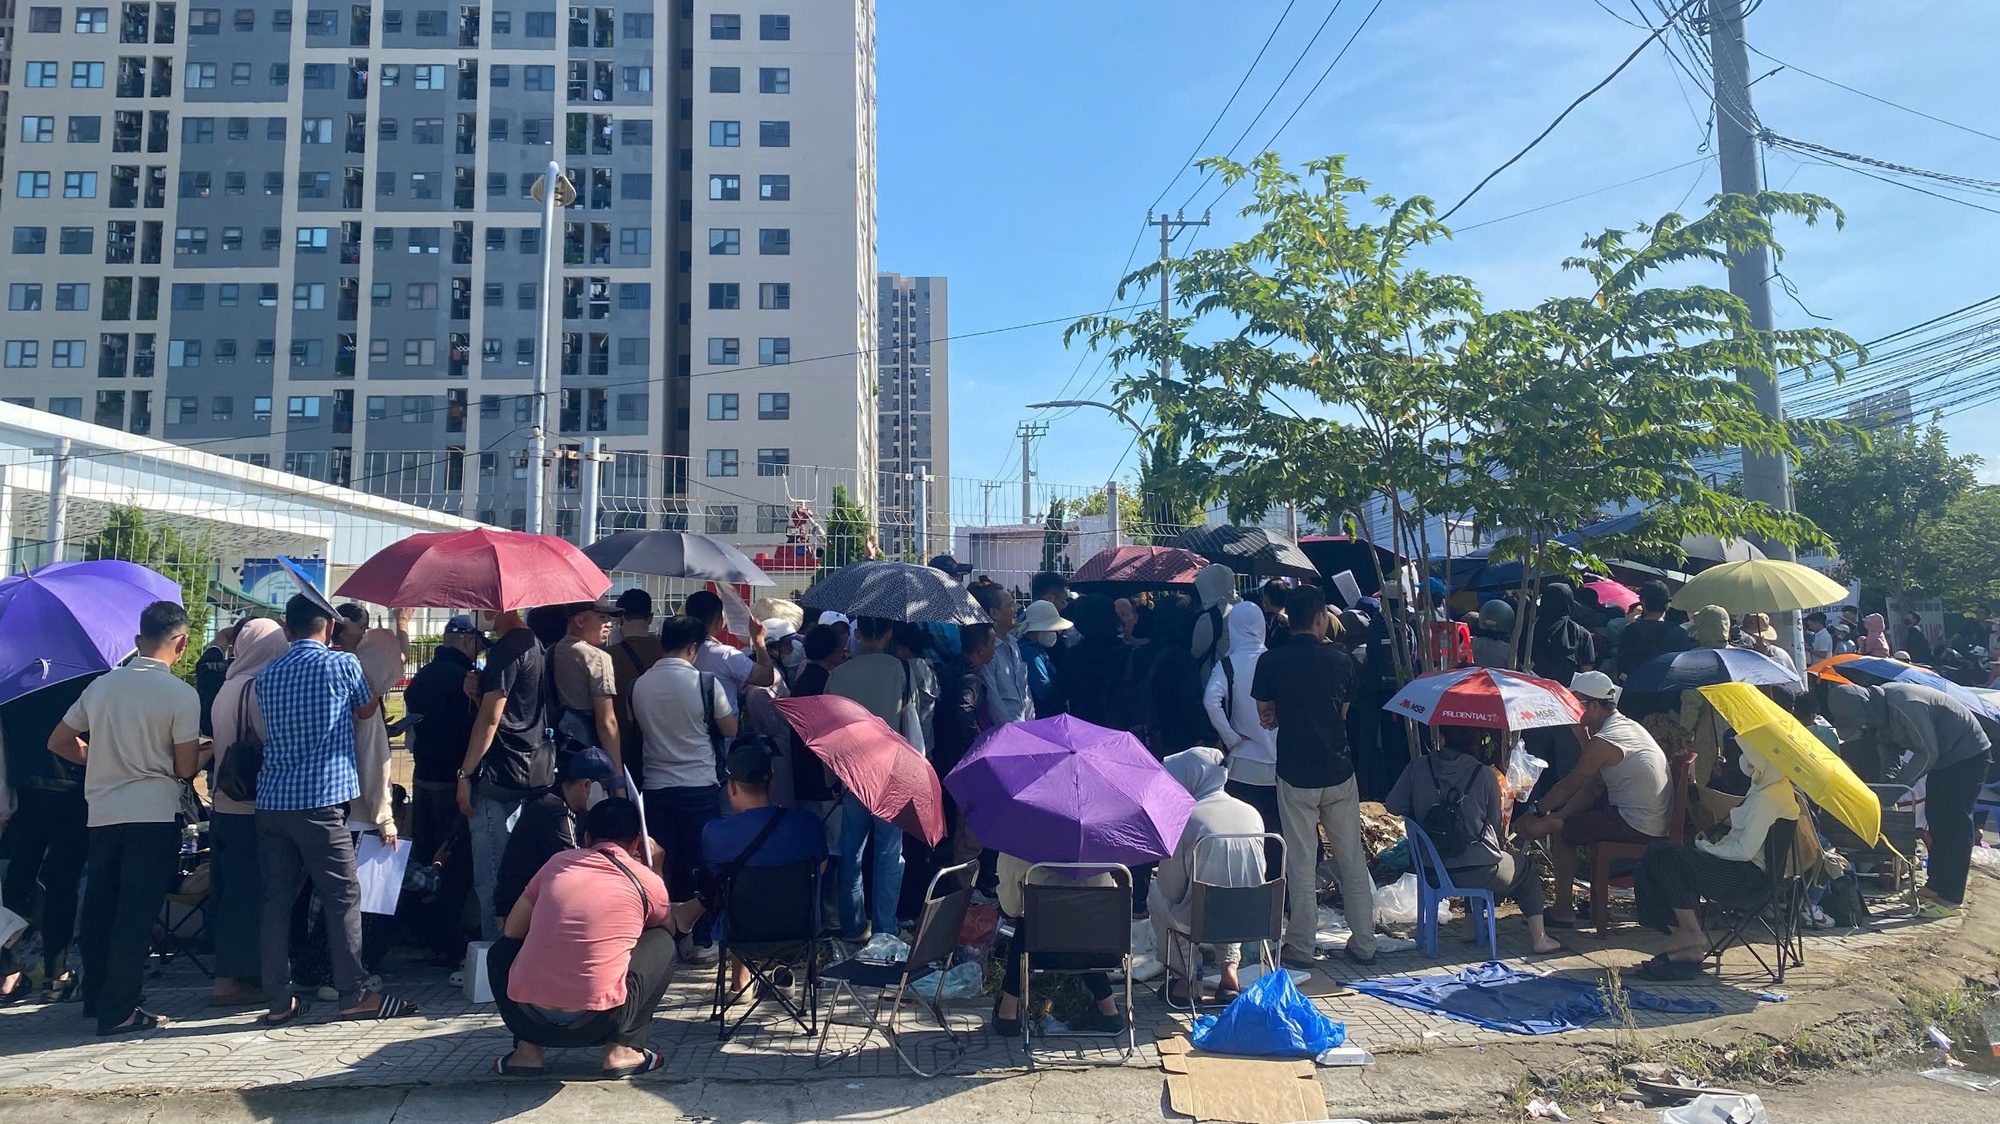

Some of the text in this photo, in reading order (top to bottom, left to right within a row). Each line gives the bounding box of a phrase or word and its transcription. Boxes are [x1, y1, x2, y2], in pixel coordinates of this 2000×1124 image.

[1410, 703, 1426, 714] MSB
[1535, 709, 1555, 718] MSB
[1442, 710, 1487, 721] PRUDENTIAL
